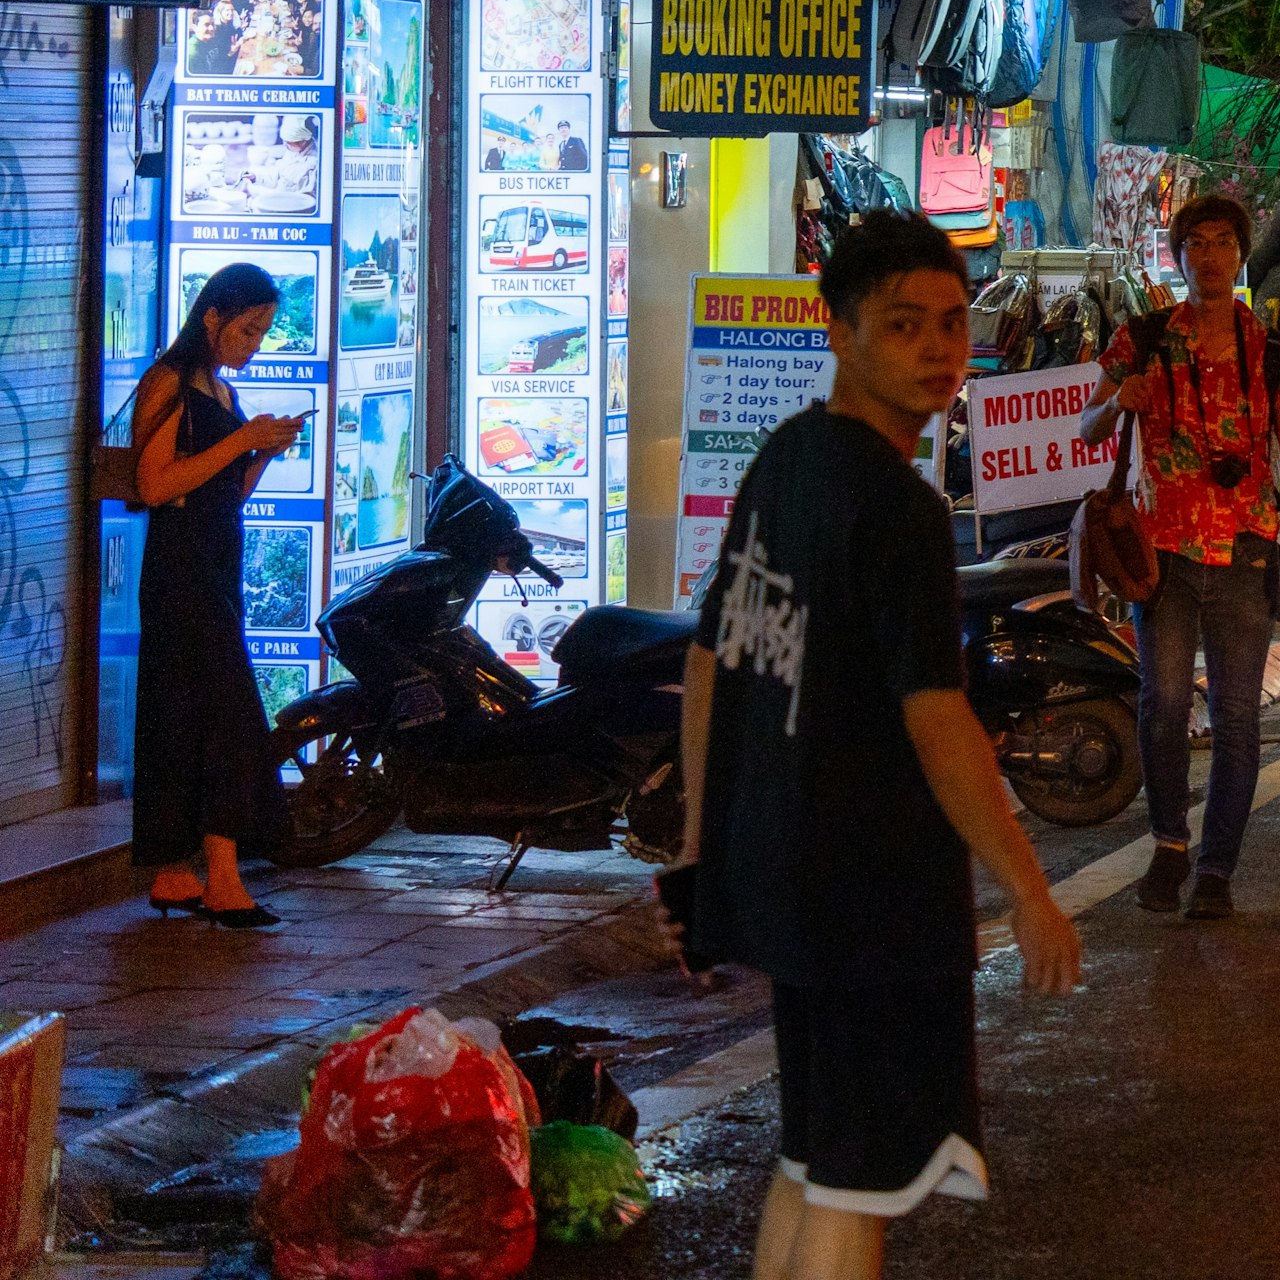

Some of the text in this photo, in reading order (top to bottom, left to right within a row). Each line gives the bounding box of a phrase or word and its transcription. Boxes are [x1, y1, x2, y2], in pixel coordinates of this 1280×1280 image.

[489, 76, 580, 89] FLIGHT TICKET
[186, 89, 320, 104] BAT TRANG CERAMIC
[659, 72, 861, 116] MONEY EXCHANGE
[344, 164, 384, 181] HALONG BAY
[499, 177, 570, 190] BUS TICKET
[192, 227, 307, 241] HOA LU TAM COC
[491, 278, 576, 291] TRAIN TICKET
[704, 294, 744, 322] BIG
[719, 331, 805, 347] HALONG
[374, 360, 413, 382] CAT BA ISLAND
[726, 356, 824, 373] Halong bay
[250, 366, 314, 379] TRANG AN
[491, 380, 575, 393] VISA SERVICE
[724, 375, 816, 391] 1 day tour:
[722, 393, 732, 405] 2
[737, 393, 778, 409] days
[722, 411, 777, 426] 3 days
[719, 459, 729, 470] 2
[981, 446, 1037, 481] SELL
[1046, 441, 1063, 473] &
[491, 482, 574, 495] AIRPORT TAXI
[718, 477, 728, 489] 3
[242, 503, 275, 516] CAVE
[503, 584, 561, 597] LAUNDRY
[264, 642, 300, 654] PARK
